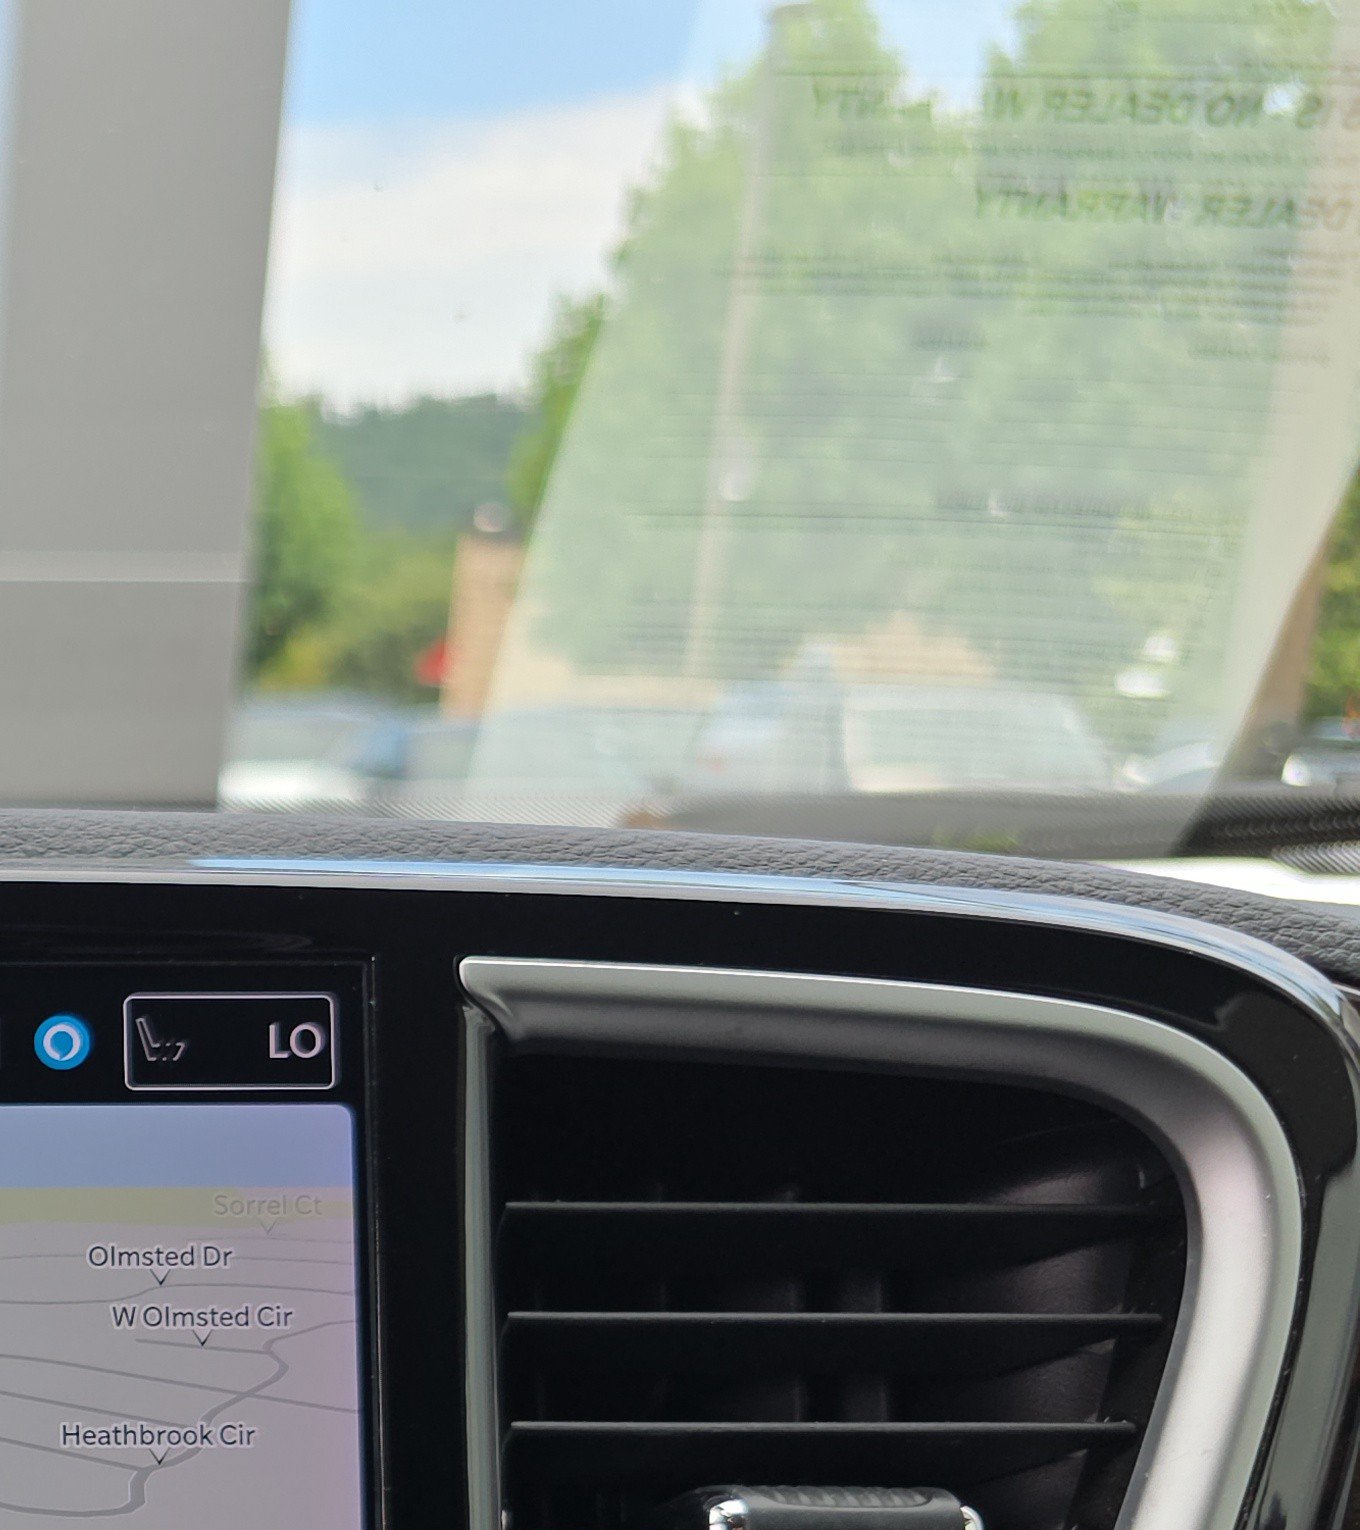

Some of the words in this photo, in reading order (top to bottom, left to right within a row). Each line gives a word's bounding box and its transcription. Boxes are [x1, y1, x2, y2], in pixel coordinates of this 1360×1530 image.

[268, 1024, 323, 1060] LO
[213, 1194, 288, 1216] Sorrel
[292, 1194, 323, 1216] Ct
[87, 1244, 194, 1267] Olmsted
[202, 1246, 233, 1267] Dr
[111, 1306, 138, 1328] W
[140, 1305, 251, 1328] Olmsted
[256, 1306, 294, 1328] Cir
[60, 1424, 215, 1447] Heathbrook
[221, 1424, 257, 1447] Cir
